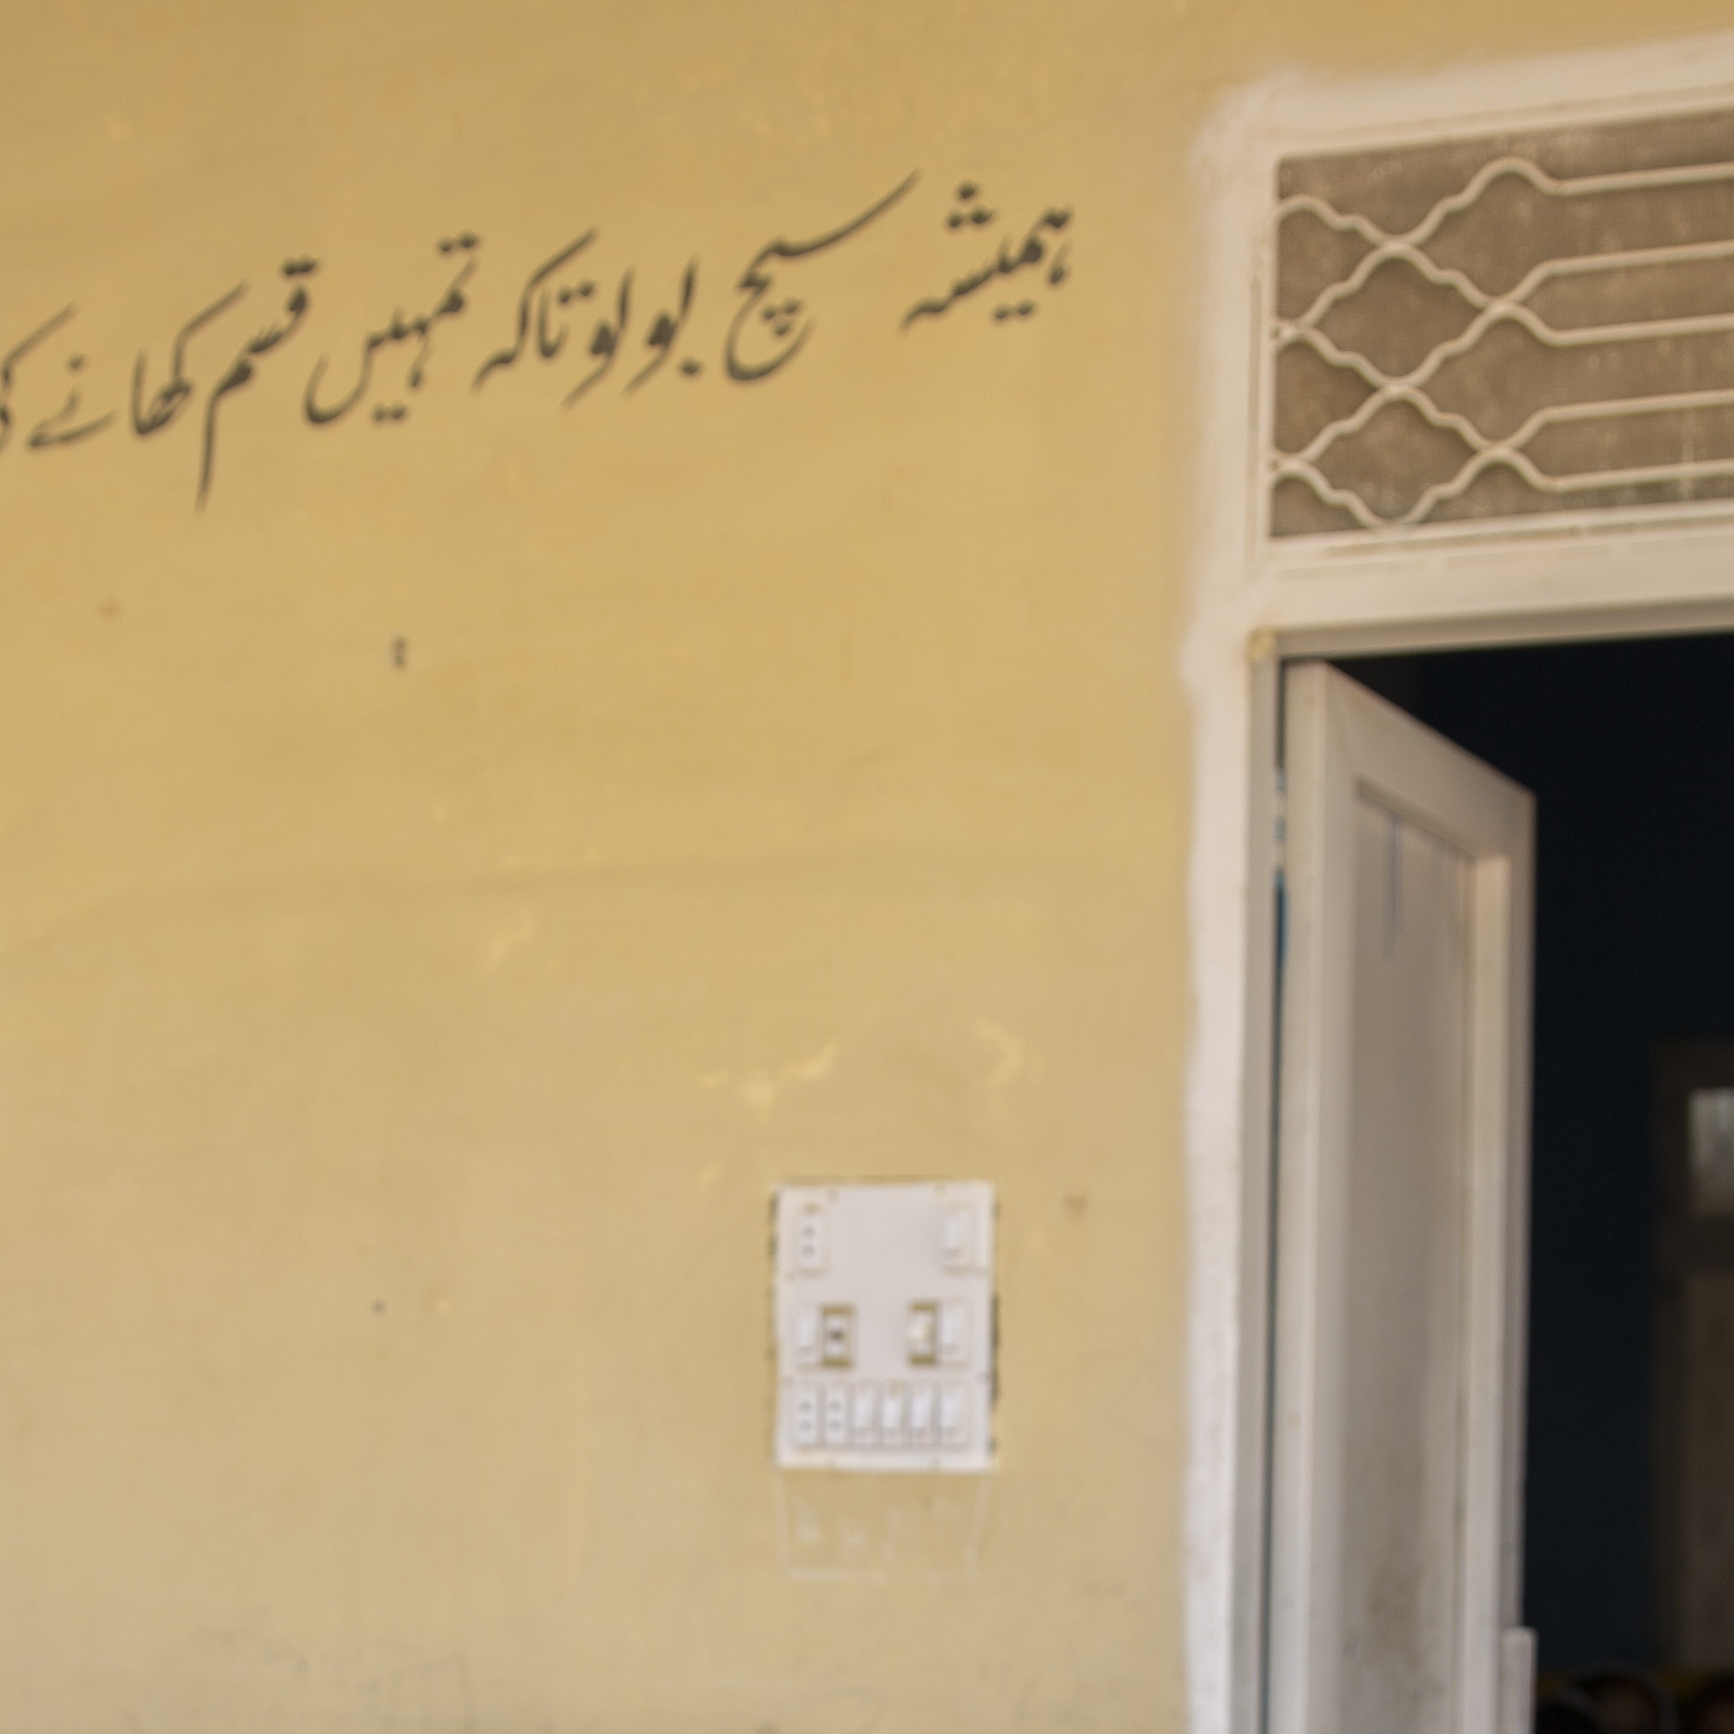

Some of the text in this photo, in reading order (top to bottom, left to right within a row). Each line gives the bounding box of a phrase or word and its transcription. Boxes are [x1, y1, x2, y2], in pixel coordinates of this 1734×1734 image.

[303, 229, 481, 426] تمہیں
[472, 226, 599, 392] تاکہ
[561, 252, 704, 408] بولو
[725, 167, 923, 383] سچ
[898, 181, 1074, 336] ہمیشہ
[28, 280, 250, 449] کھانے
[194, 256, 319, 514] قسم
